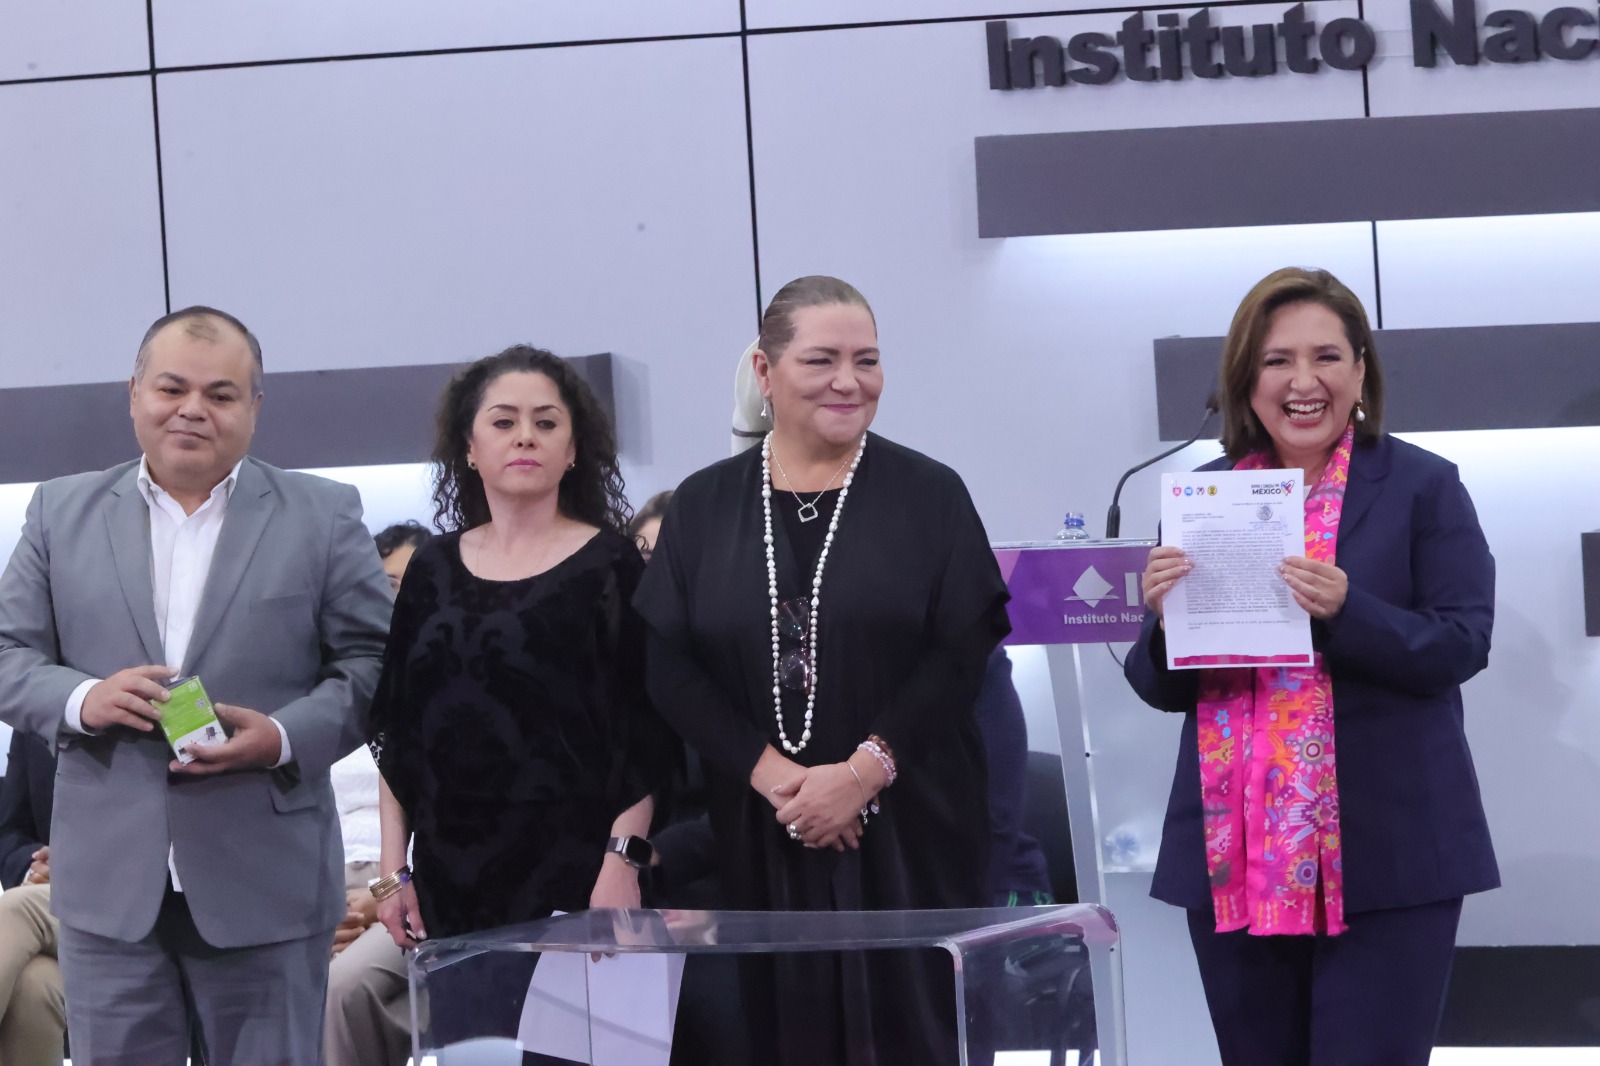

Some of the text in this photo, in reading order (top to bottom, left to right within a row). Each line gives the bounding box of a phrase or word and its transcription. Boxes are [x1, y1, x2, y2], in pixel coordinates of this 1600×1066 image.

[986, 0, 1600, 90] Instituto Nac
[1063, 613, 1118, 625] Instituto
